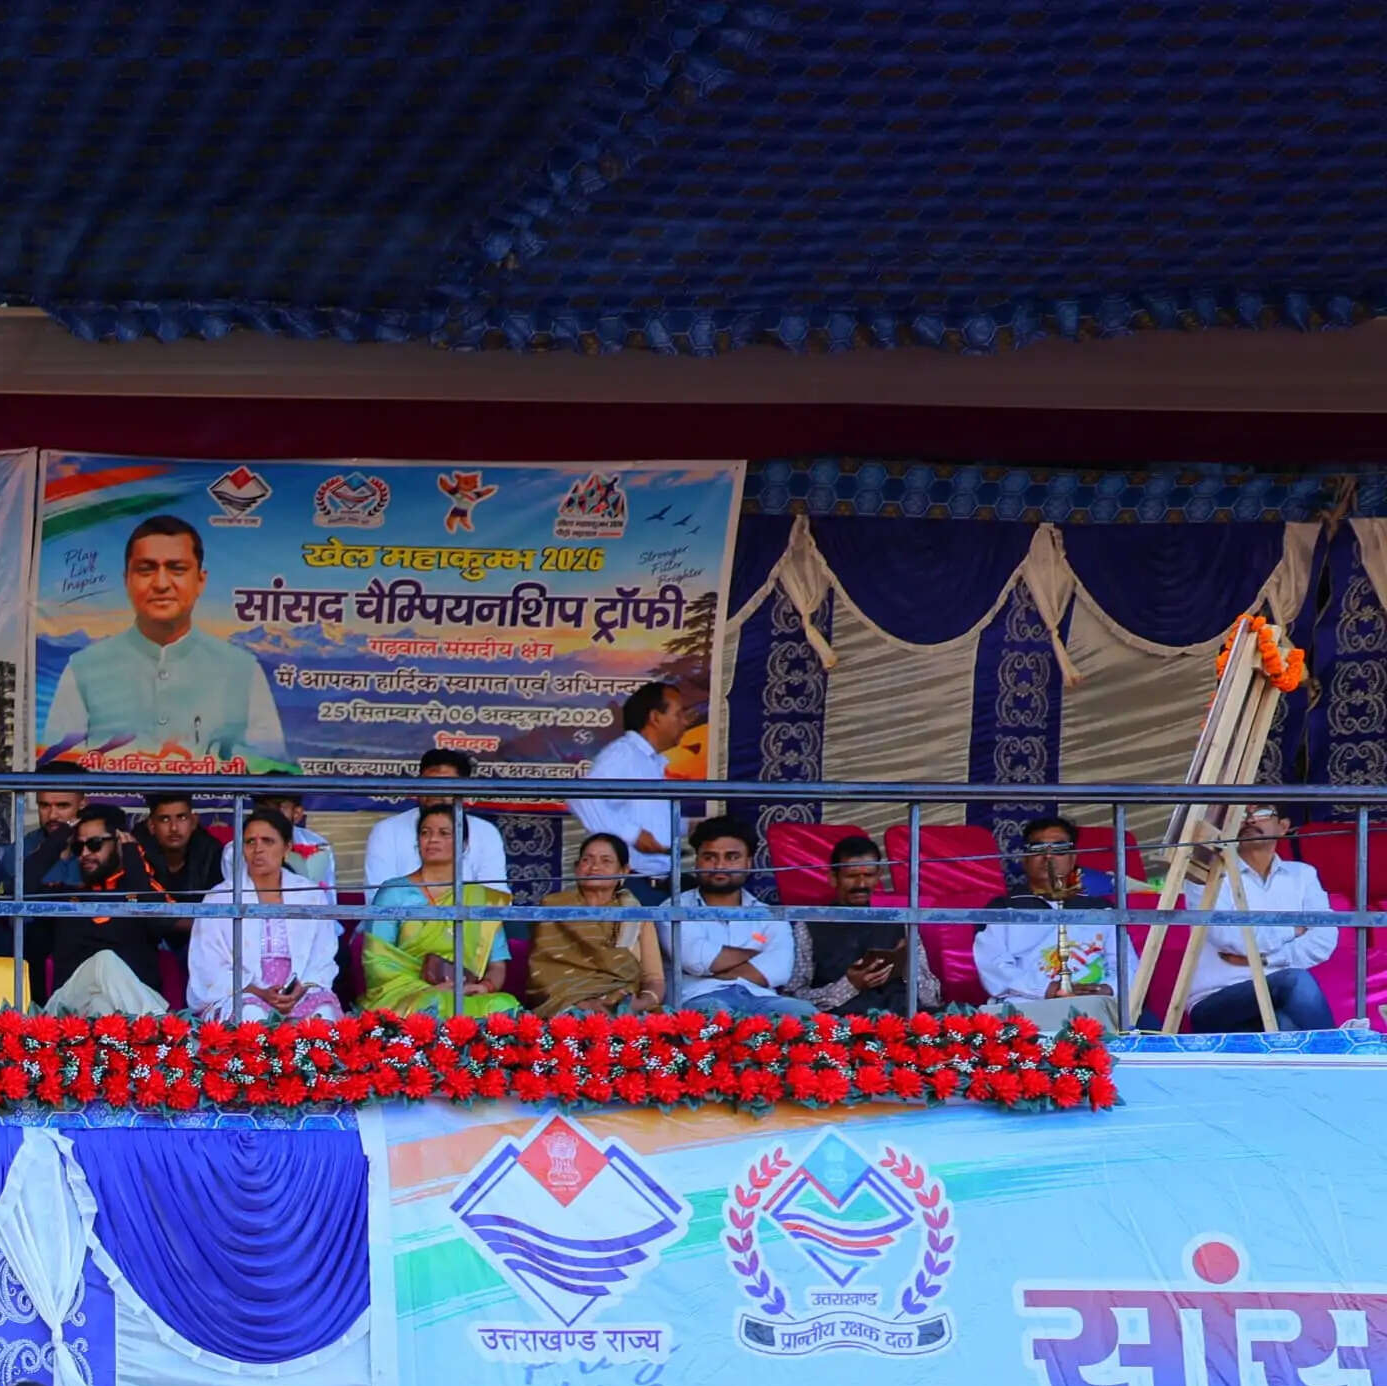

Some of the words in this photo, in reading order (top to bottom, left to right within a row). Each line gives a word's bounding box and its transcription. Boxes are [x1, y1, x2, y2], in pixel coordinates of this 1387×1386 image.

[303, 536, 377, 568] खेल
[382, 547, 537, 582] महाकुम्भ
[540, 547, 605, 571] 2026
[234, 576, 349, 623] सांसद
[355, 578, 589, 629] चैम्पियनशिप
[594, 584, 687, 644] ट्रॉफी
[369, 640, 437, 660] गढ़वाल
[276, 665, 296, 689] में
[300, 671, 369, 691] आपका
[448, 708, 475, 723] 06
[559, 709, 613, 727] 2026
[477, 1328, 597, 1352] उत्तराखण्ड
[603, 1329, 662, 1353] राज्य
[885, 1330, 913, 1349] दल
